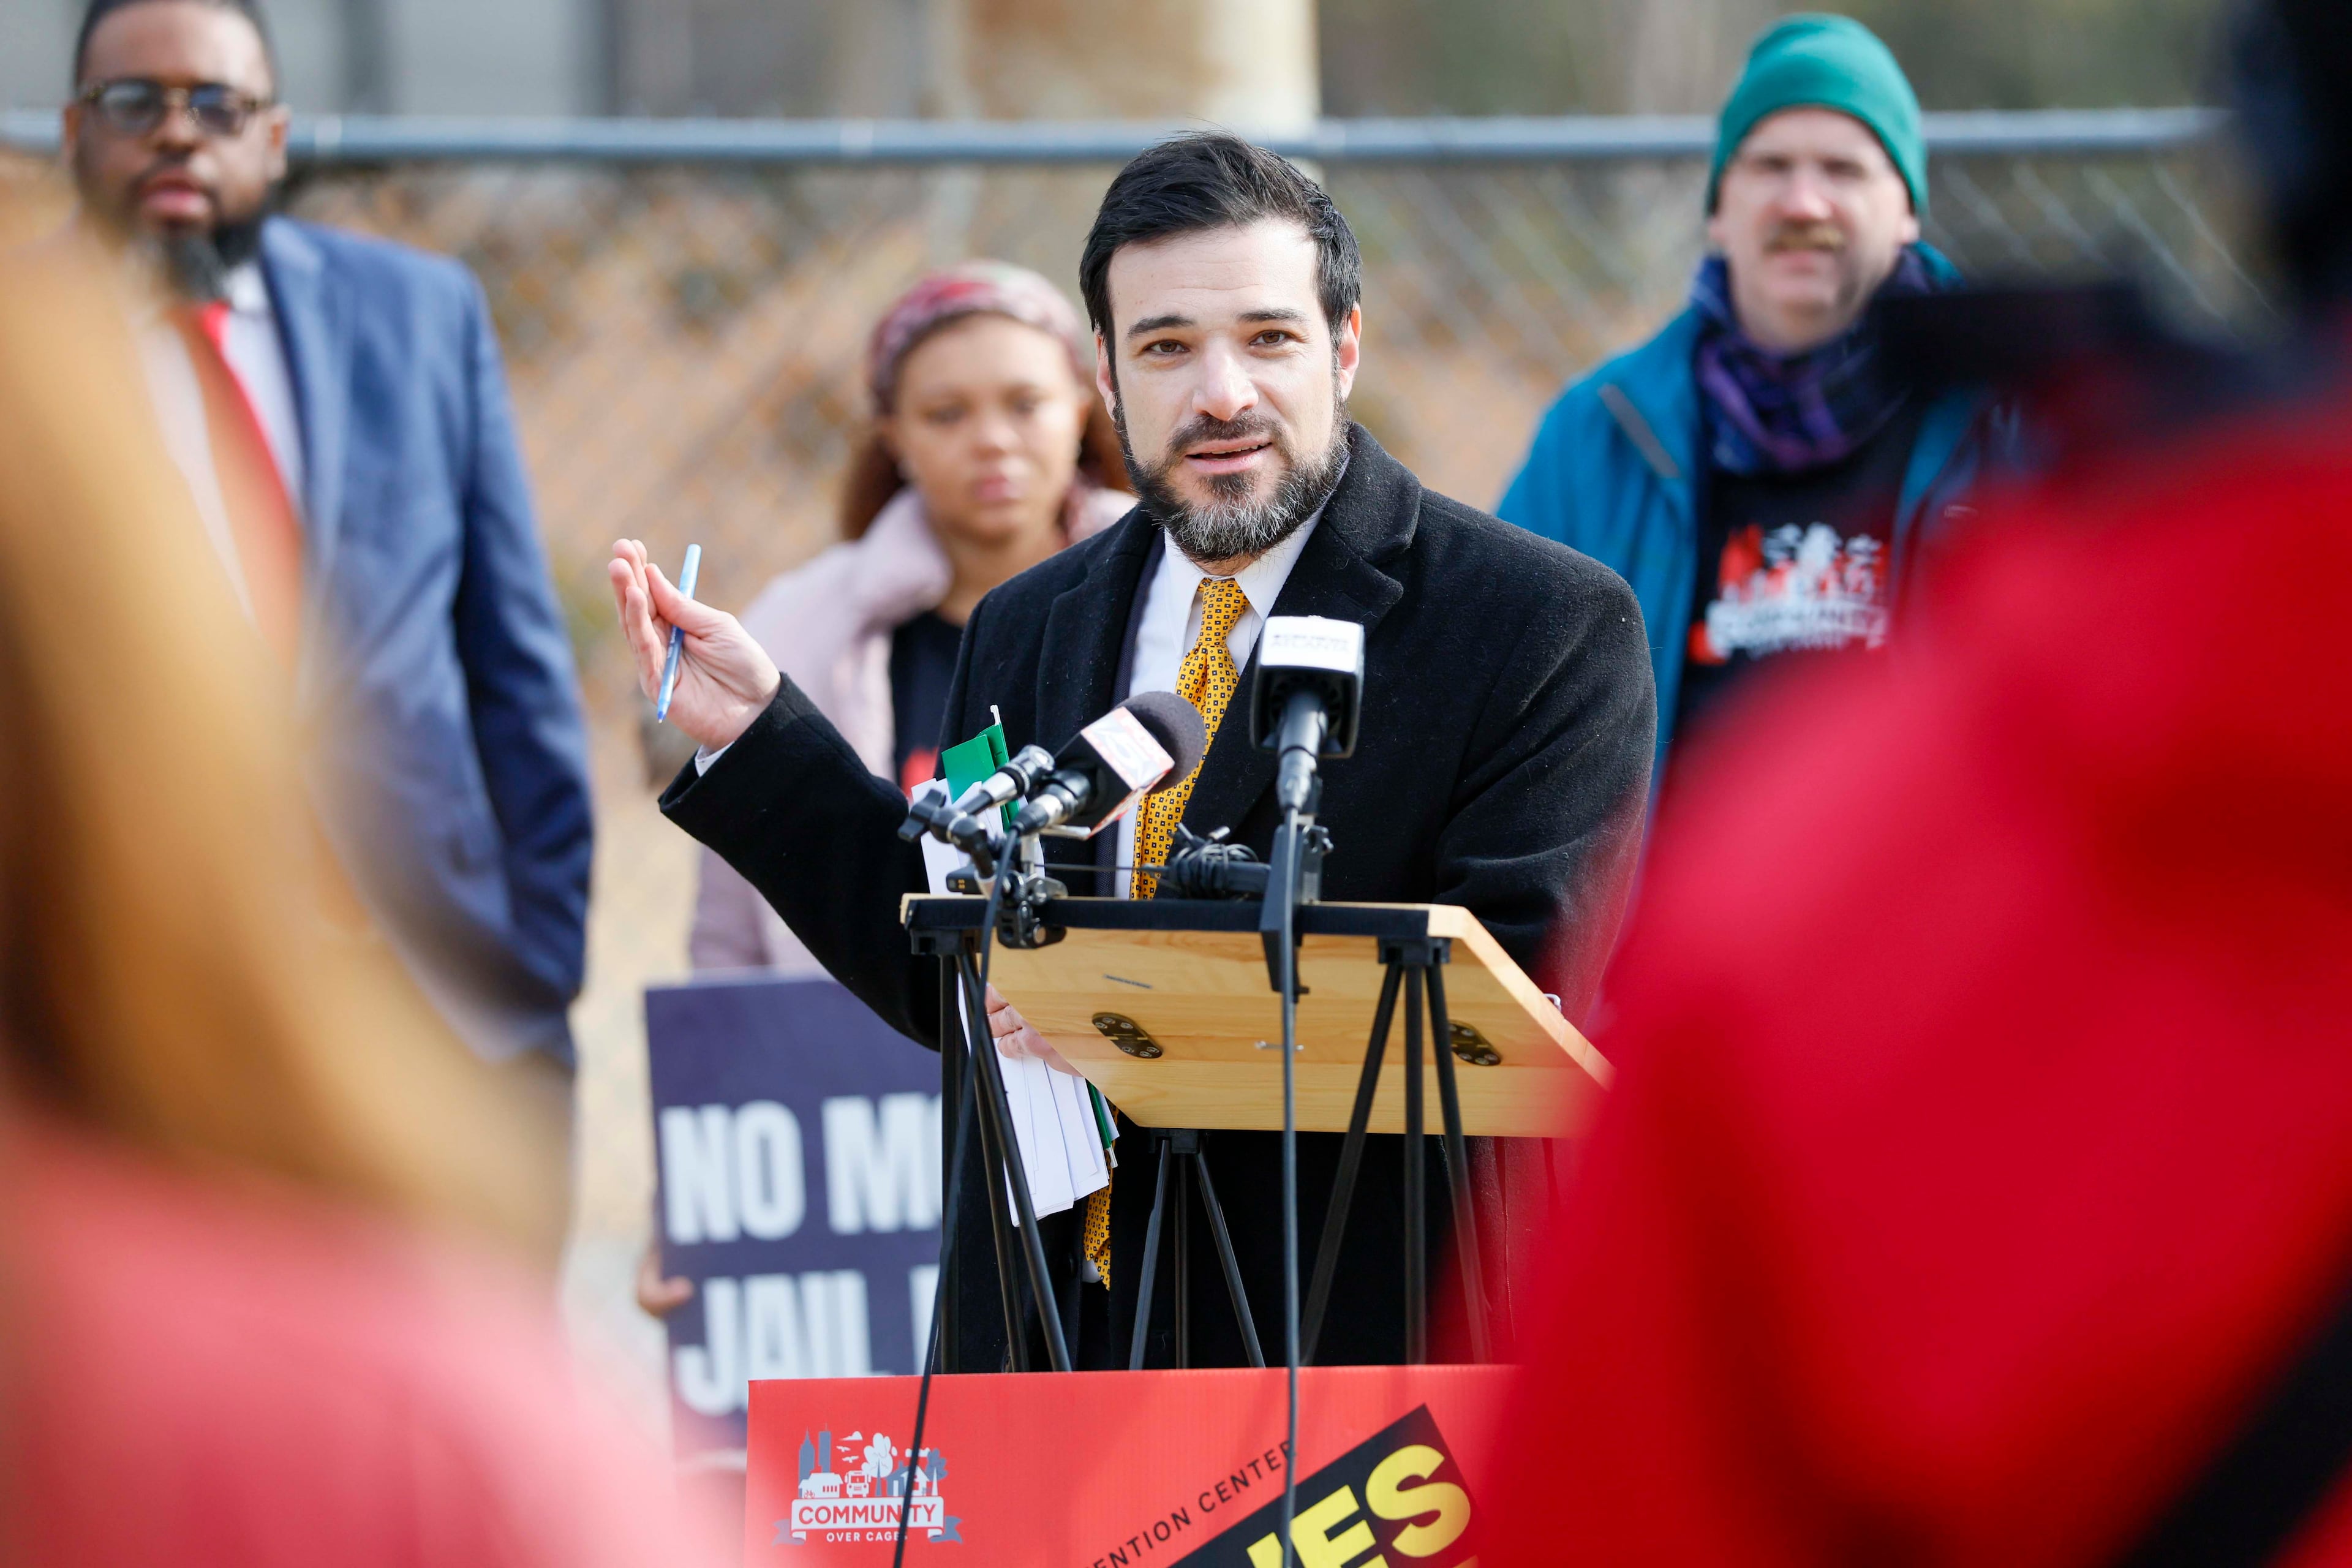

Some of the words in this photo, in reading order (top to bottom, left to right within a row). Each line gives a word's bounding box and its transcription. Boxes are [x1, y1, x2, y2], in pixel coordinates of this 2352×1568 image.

[660, 1101, 805, 1244] NO
[821, 1092, 942, 1232] M
[676, 1272, 893, 1416] JAIL
[799, 1504, 937, 1525] COMMUNTY
[826, 1532, 861, 1542] OVER
[866, 1531, 908, 1542] CAGE
